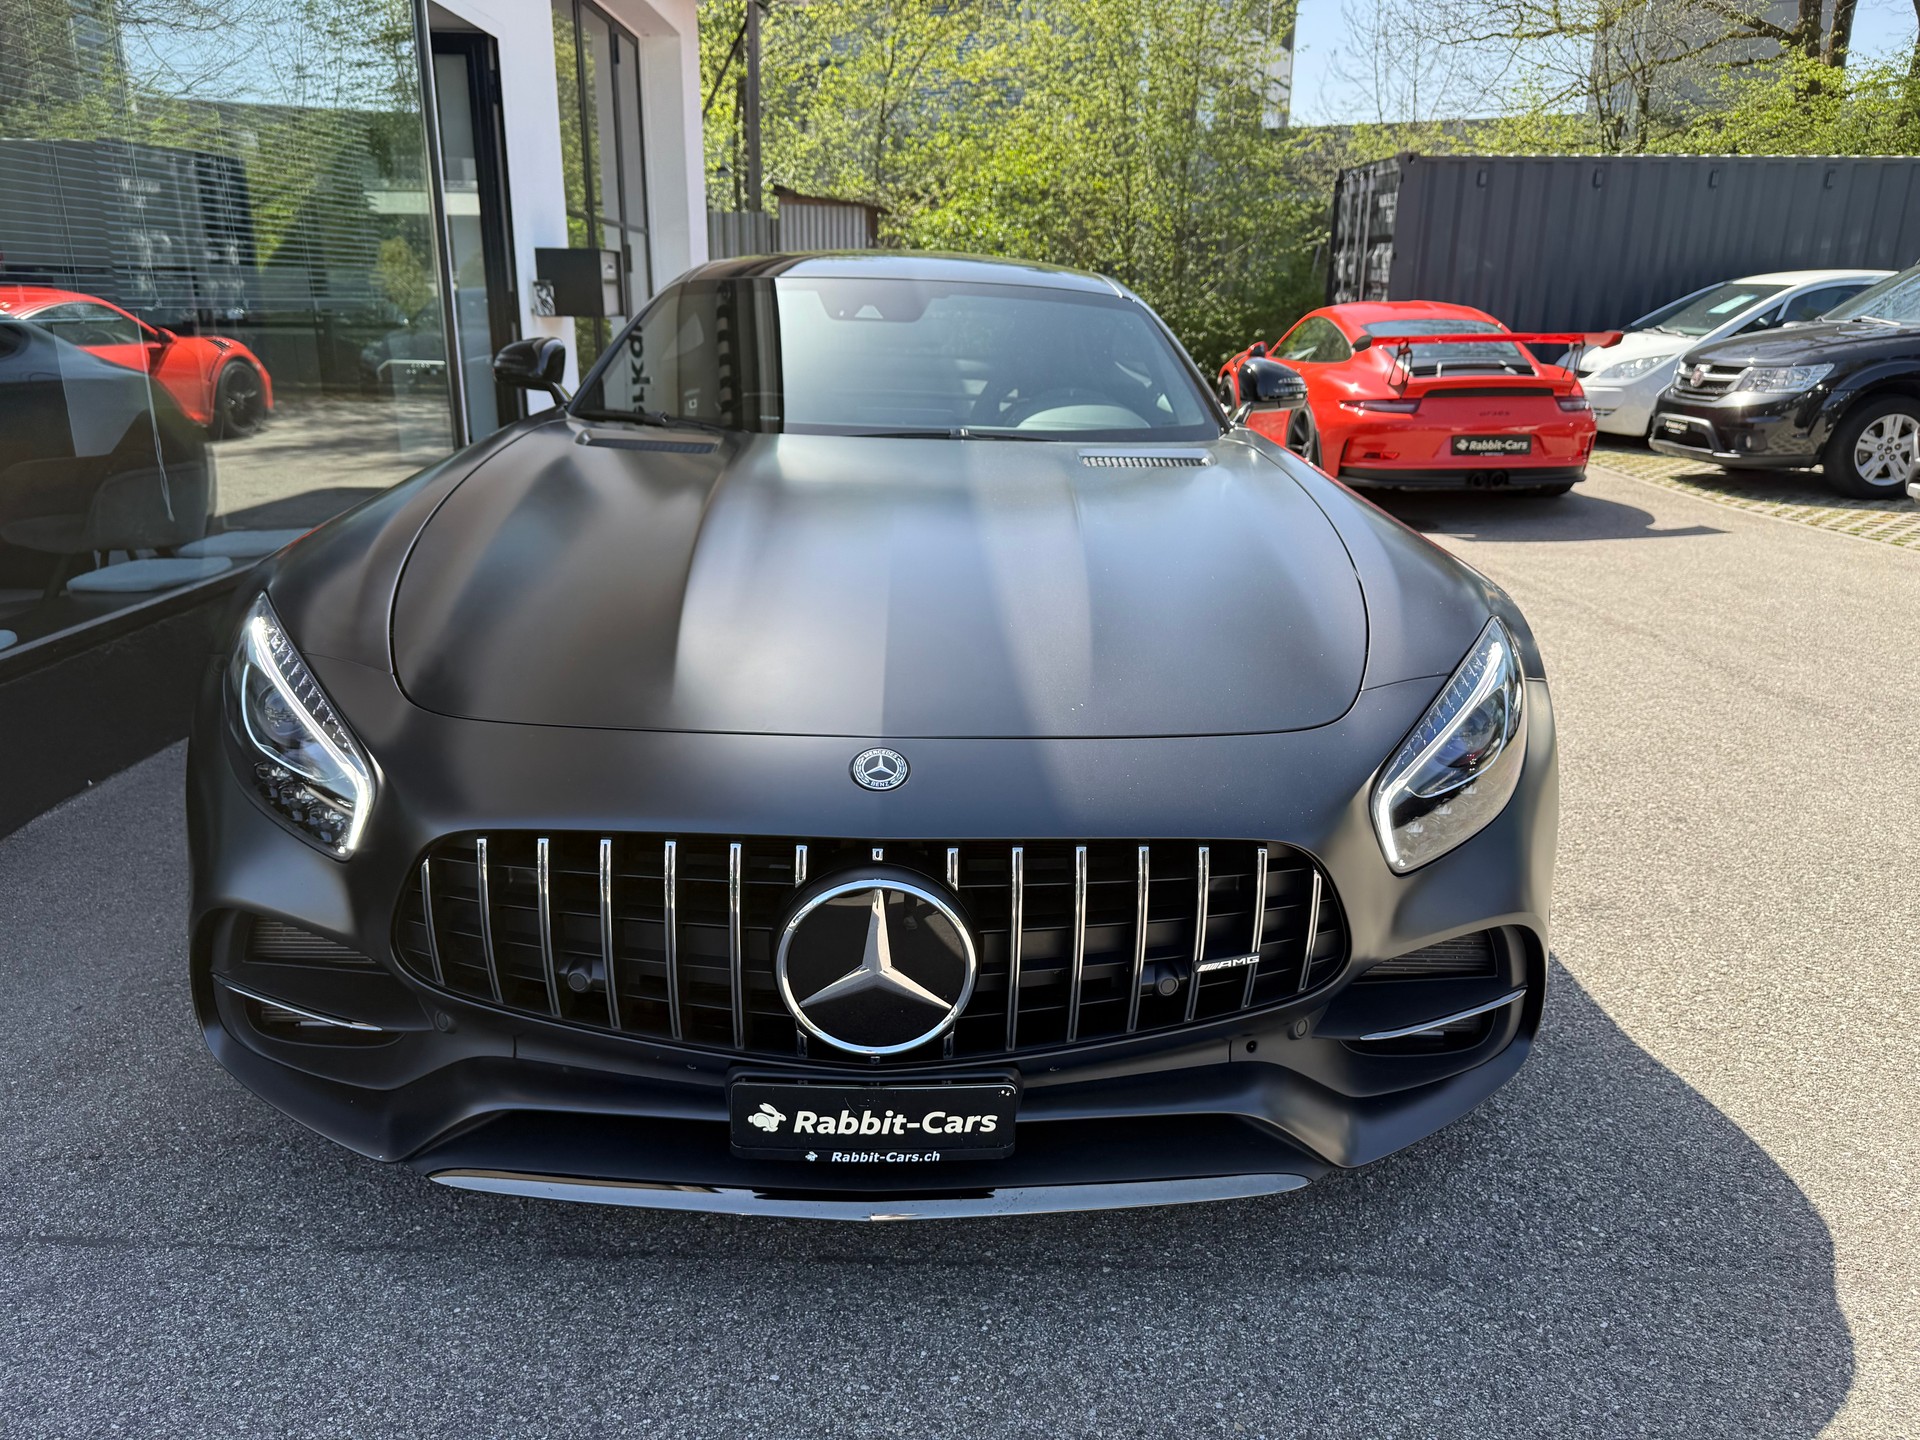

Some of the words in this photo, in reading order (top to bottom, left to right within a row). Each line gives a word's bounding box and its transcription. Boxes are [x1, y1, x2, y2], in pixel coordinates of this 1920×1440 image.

[1469, 439, 1528, 451] Rabbit-Cars
[1216, 955, 1260, 969] AMG
[793, 1110, 998, 1135] Rabbit-Cars
[831, 1151, 941, 1163] Rabbit-Cars.ch
